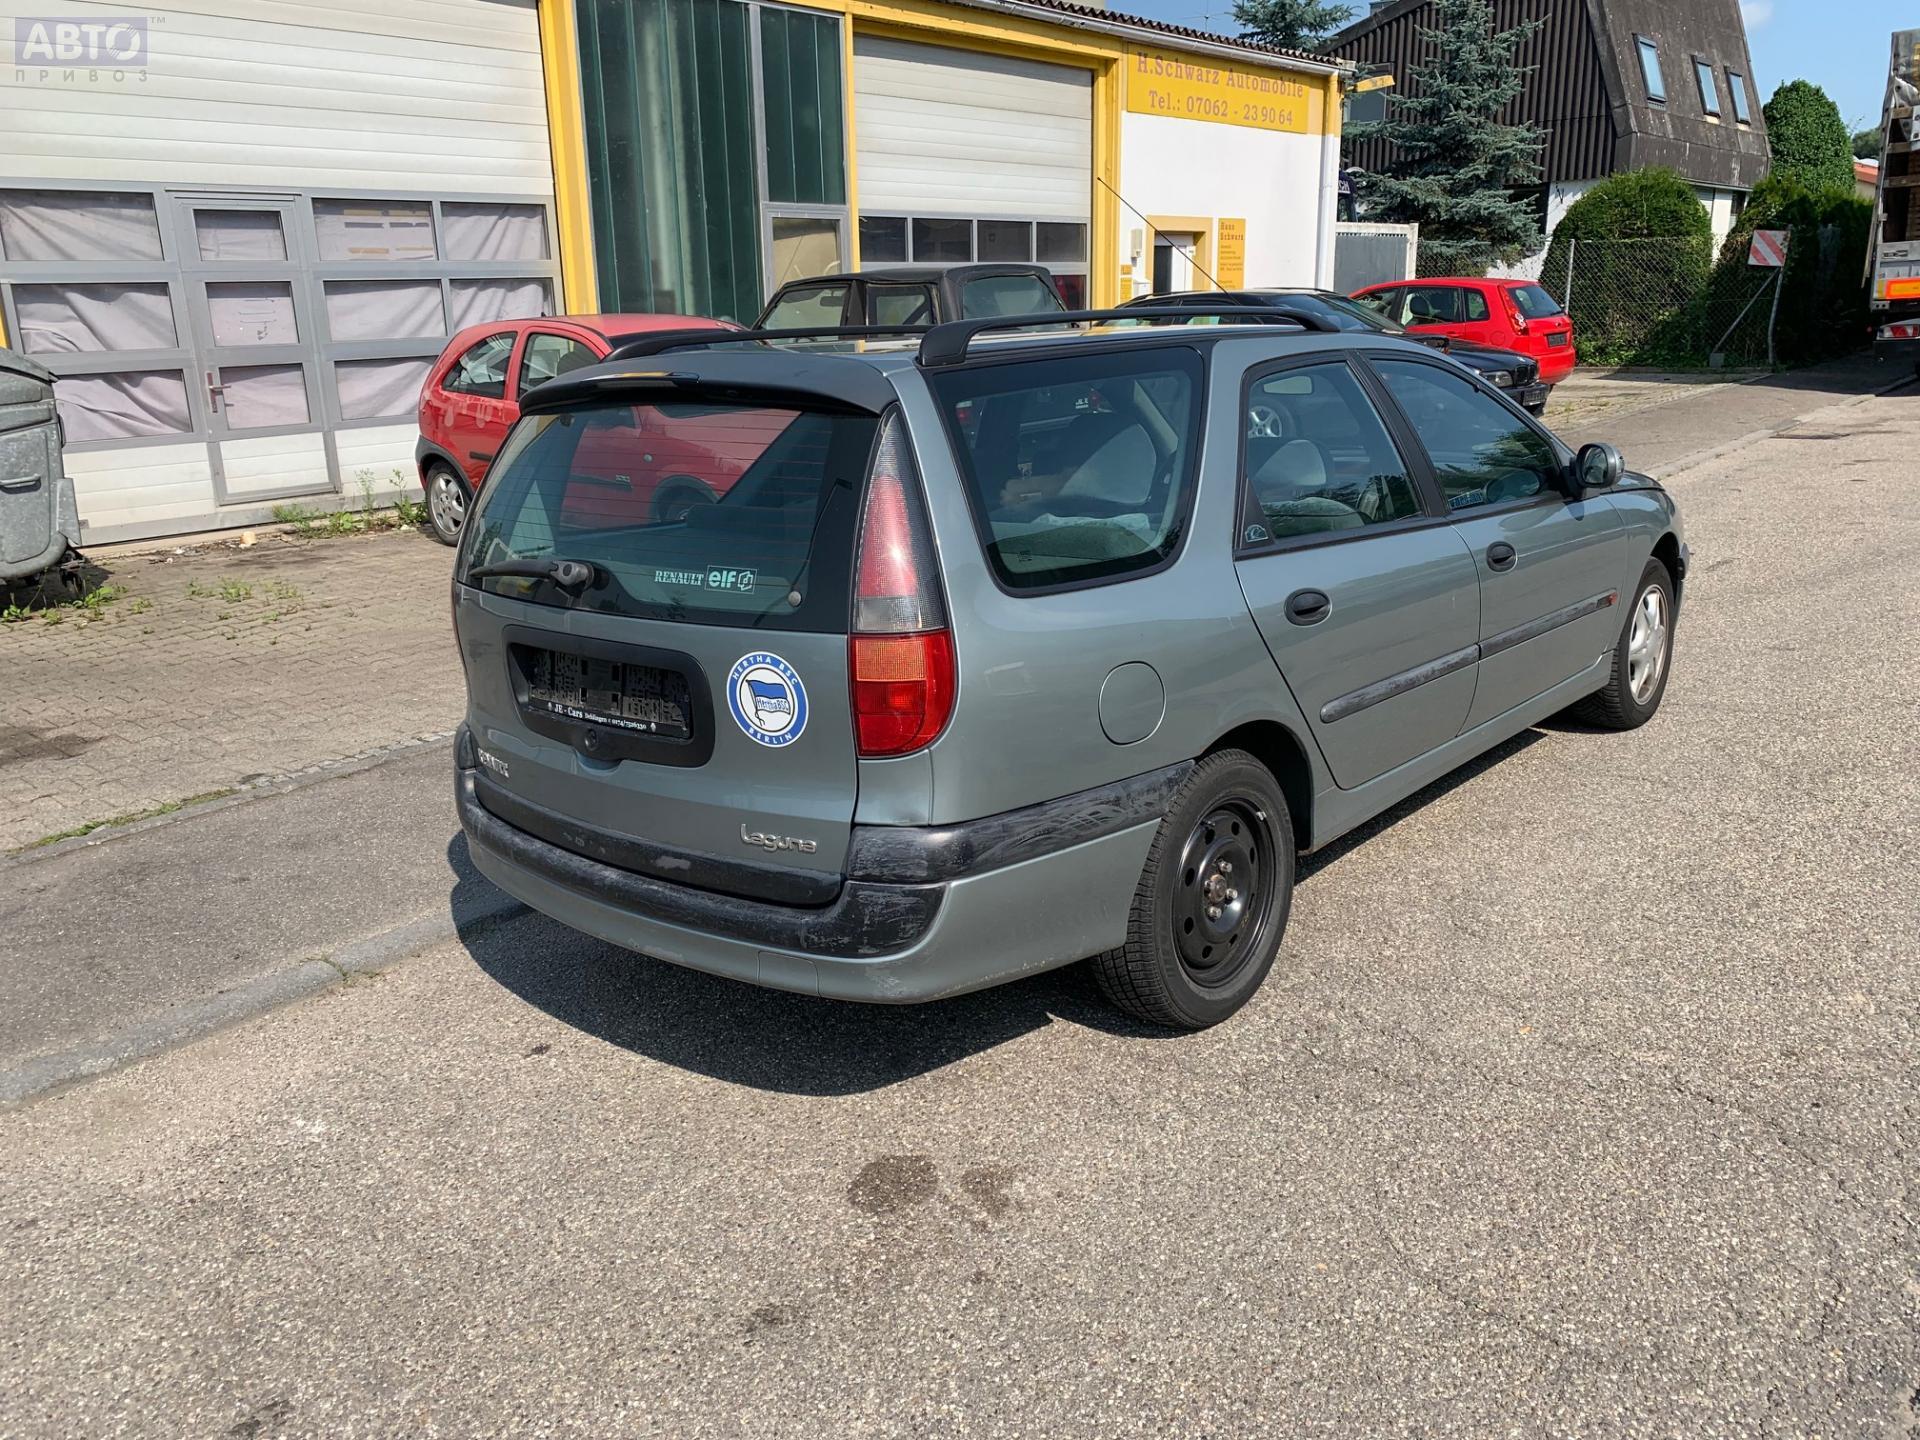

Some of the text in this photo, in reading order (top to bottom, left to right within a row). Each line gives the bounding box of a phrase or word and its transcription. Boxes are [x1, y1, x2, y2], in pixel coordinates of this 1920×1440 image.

[1136, 52, 1304, 99] H.Schwarz Automobile
[1148, 90, 1181, 111] Tel.:
[1186, 96, 1229, 117] 07062
[654, 570, 737, 588] RENAULT elf
[732, 655, 798, 686] HERTHA BSC
[568, 706, 583, 719] Cars
[748, 727, 793, 745] BERLIN
[740, 823, 818, 854] Laguna
